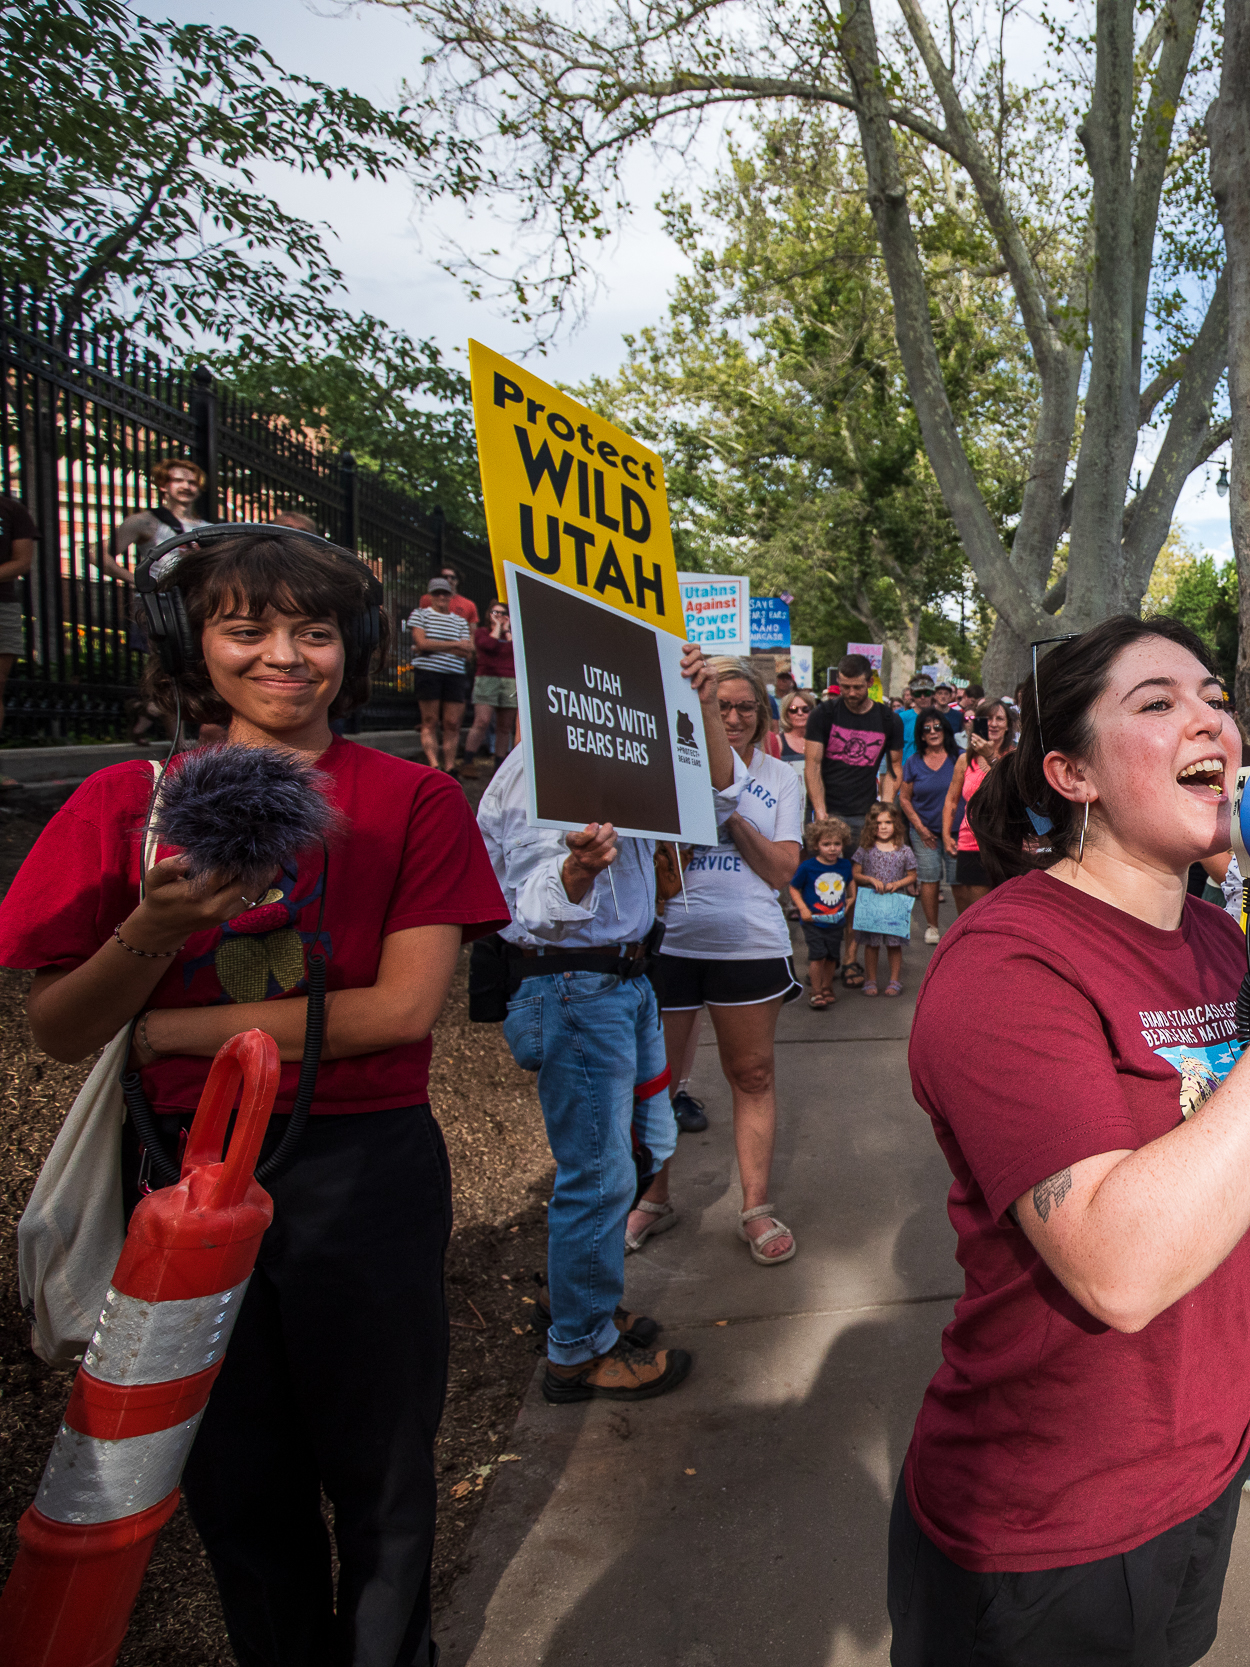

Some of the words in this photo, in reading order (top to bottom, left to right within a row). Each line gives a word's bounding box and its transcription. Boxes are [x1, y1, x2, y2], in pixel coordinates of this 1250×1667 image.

[494, 371, 656, 490] Protect
[514, 424, 652, 544] WILD
[519, 503, 665, 616] UTAH
[685, 585, 736, 599] Utahns
[685, 598, 736, 614] Against
[749, 599, 774, 609] SAVE
[686, 612, 736, 627] Power
[751, 623, 780, 632] RAND
[687, 626, 737, 643] Grabs
[583, 664, 622, 697] UTAH
[547, 685, 615, 728] STANDS
[616, 704, 657, 739] WITH
[566, 725, 613, 758] BEARS
[616, 737, 649, 766] EARS
[747, 780, 777, 808] ARTS
[688, 855, 742, 872] ERVICE
[1139, 1011, 1170, 1028] GRAND
[1141, 1029, 1178, 1047] BEARS
[1171, 1028, 1198, 1043] EARS
[1197, 1019, 1238, 1043] NATION
